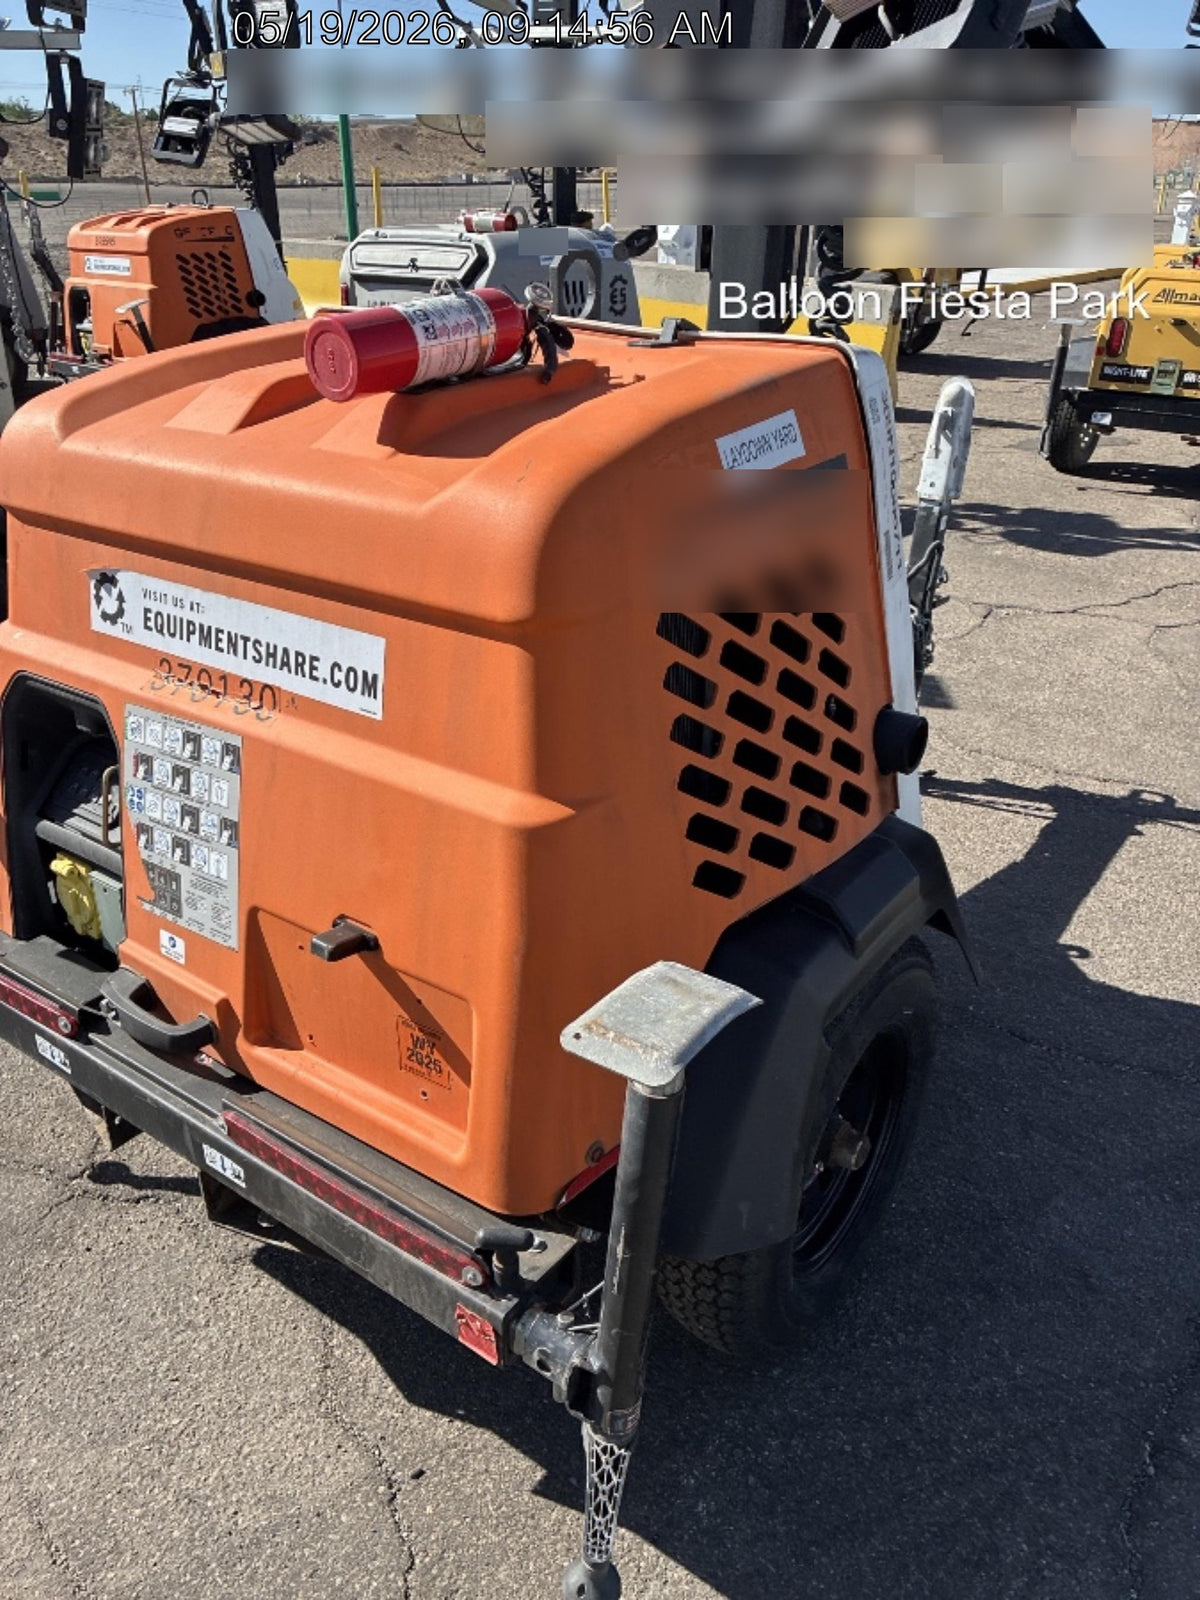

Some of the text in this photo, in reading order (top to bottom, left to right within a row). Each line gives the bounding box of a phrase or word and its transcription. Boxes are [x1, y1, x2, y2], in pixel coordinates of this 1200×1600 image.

[1152, 287, 1200, 305] Allma
[723, 422, 798, 469] LAYDOWN YARD
[141, 587, 207, 615] VISIT US AT:
[142, 607, 380, 700] EQUIPMENTSHARE.COM
